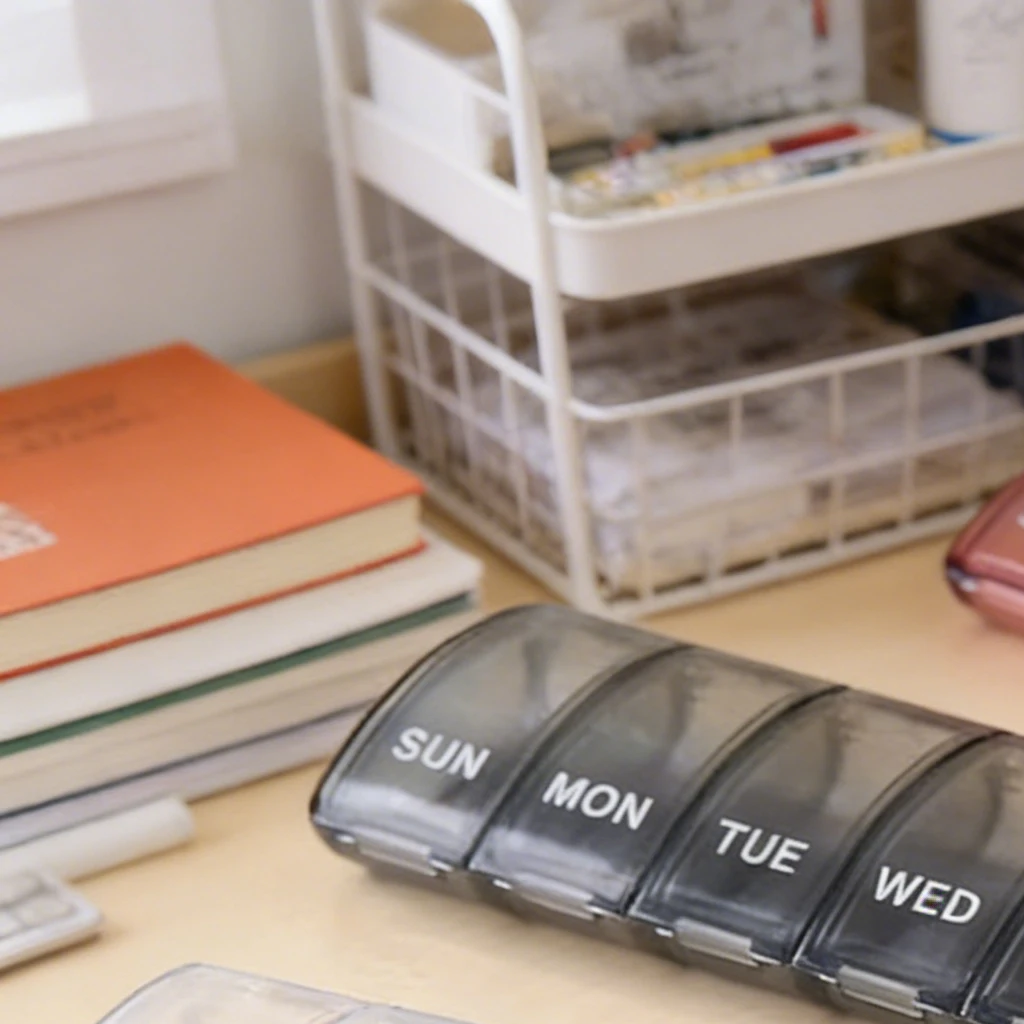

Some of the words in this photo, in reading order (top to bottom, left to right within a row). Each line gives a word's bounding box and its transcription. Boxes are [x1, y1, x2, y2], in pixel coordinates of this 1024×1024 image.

[391, 726, 491, 781] SUN
[541, 771, 654, 831] MON
[715, 818, 809, 875] TUE
[873, 865, 982, 924] WED
